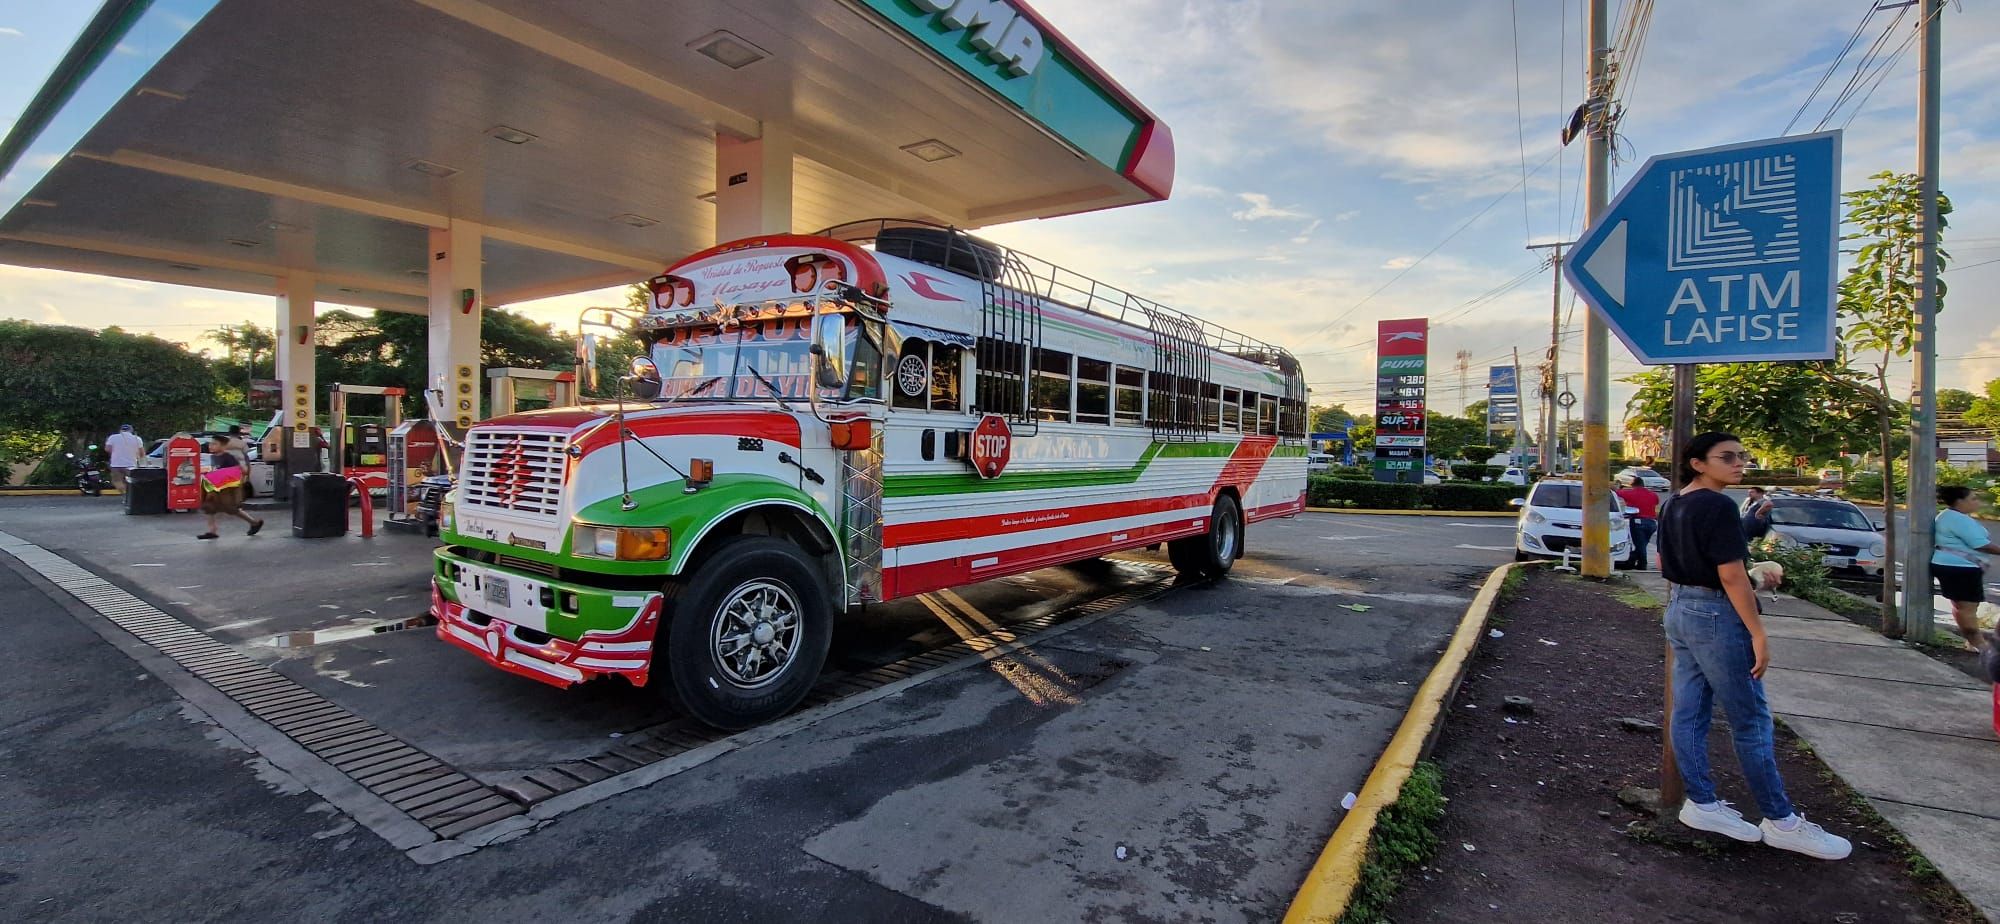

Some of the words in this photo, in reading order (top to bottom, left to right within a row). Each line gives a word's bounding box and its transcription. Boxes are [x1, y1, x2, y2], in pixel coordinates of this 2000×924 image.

[711, 279, 788, 296] Masaya
[1666, 270, 1800, 315] ATM
[1664, 312, 1799, 346] LAFISE
[1380, 359, 1425, 369] PUMA
[736, 375, 773, 397] DE
[976, 434, 1007, 458] STOP
[1397, 461, 1412, 470] ATM
